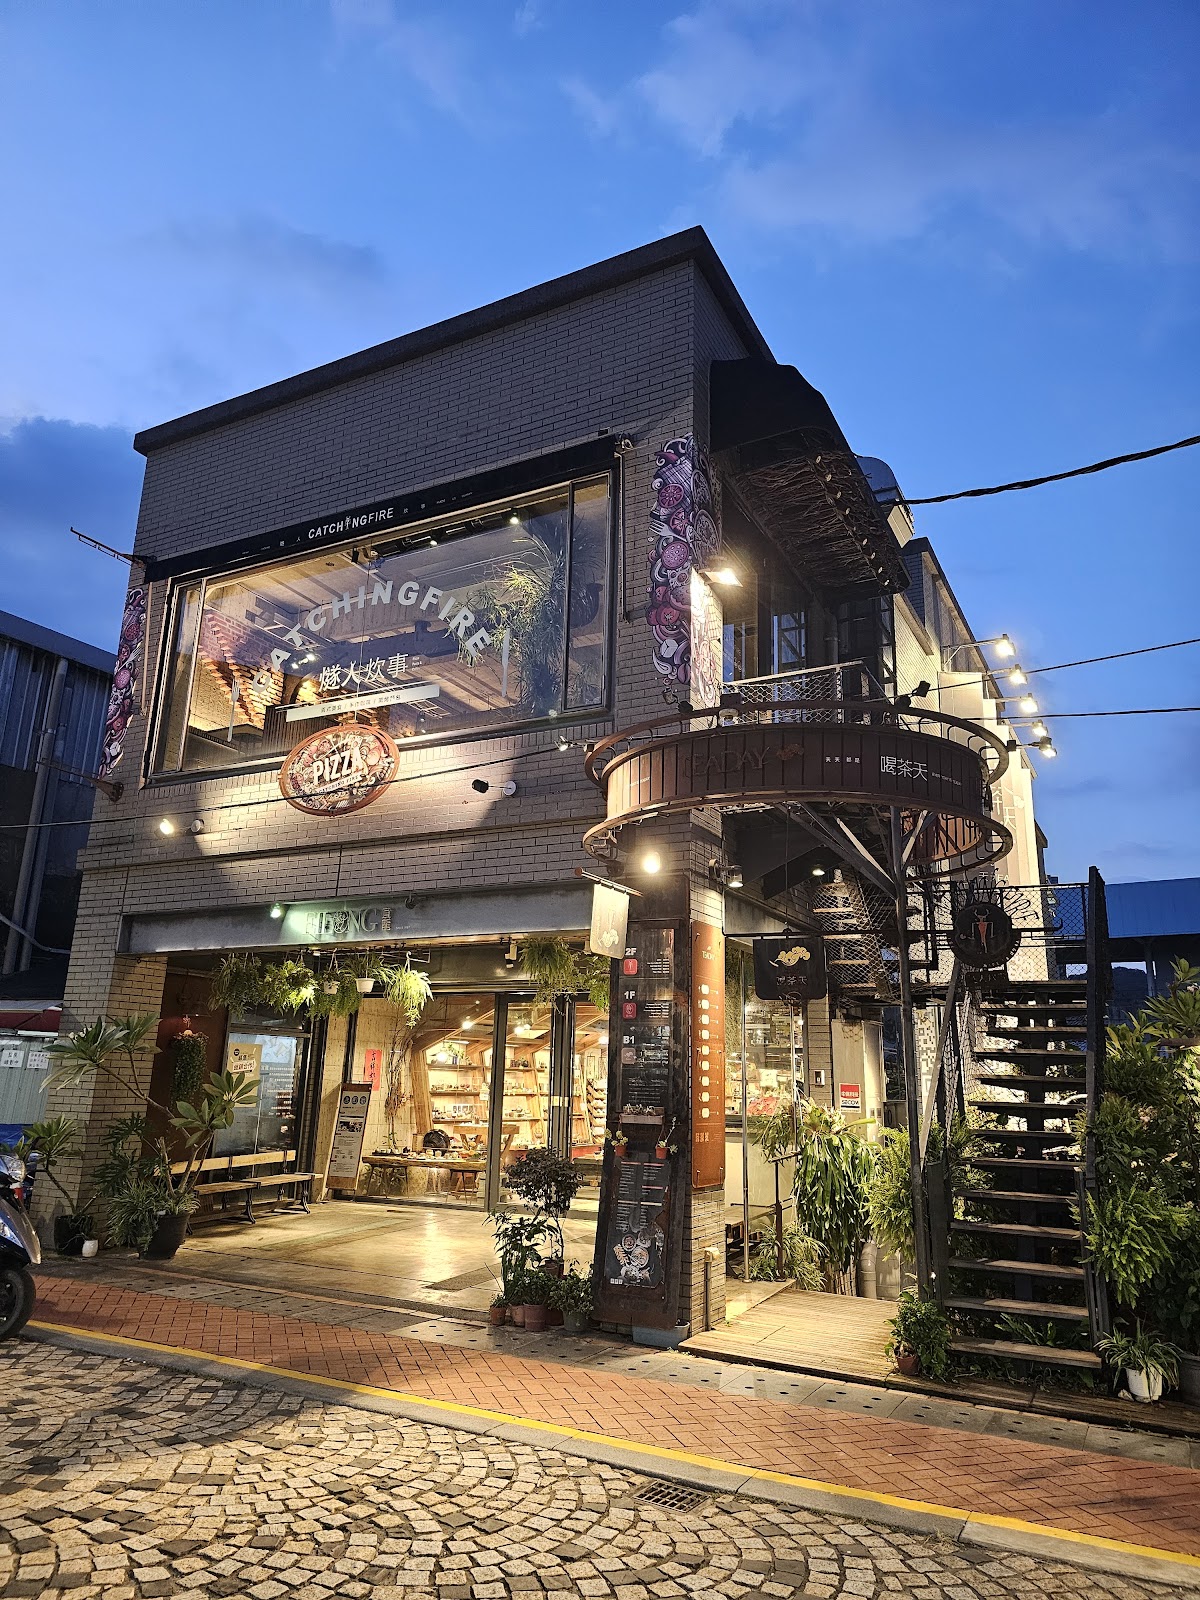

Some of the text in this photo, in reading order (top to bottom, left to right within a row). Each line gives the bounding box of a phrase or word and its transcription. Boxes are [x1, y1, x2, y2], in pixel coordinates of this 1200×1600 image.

[308, 507, 394, 539] CATCHINGFIRE
[251, 580, 493, 694] CATCHINGFIRE
[318, 652, 410, 692] 燧人炊事
[312, 746, 364, 785] PIZZA
[880, 755, 928, 781] 喝茶天
[625, 947, 637, 956] 2F
[624, 990, 636, 1000] 1F
[623, 1035, 635, 1044] B1
